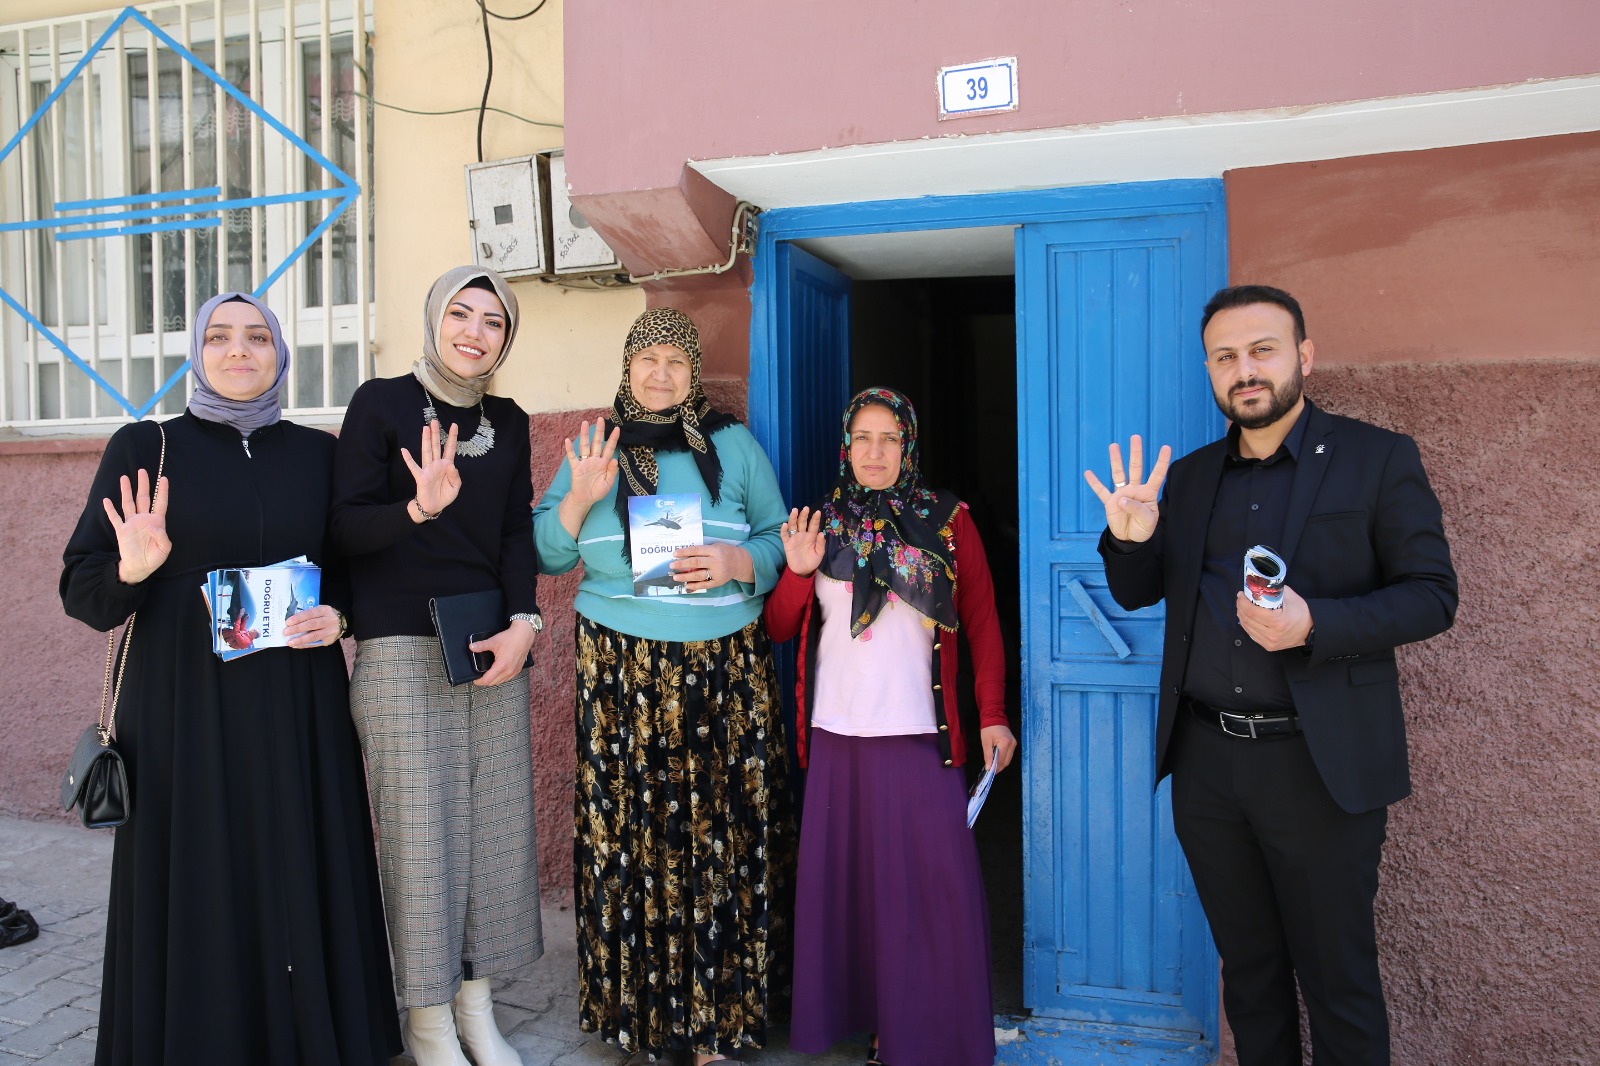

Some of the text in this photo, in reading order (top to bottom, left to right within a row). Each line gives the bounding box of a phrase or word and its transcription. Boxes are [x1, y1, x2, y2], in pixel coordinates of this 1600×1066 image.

[966, 76, 989, 101] 39
[640, 544, 673, 555] DOĞRU
[262, 579, 273, 638] DOĞRU ETKİ
